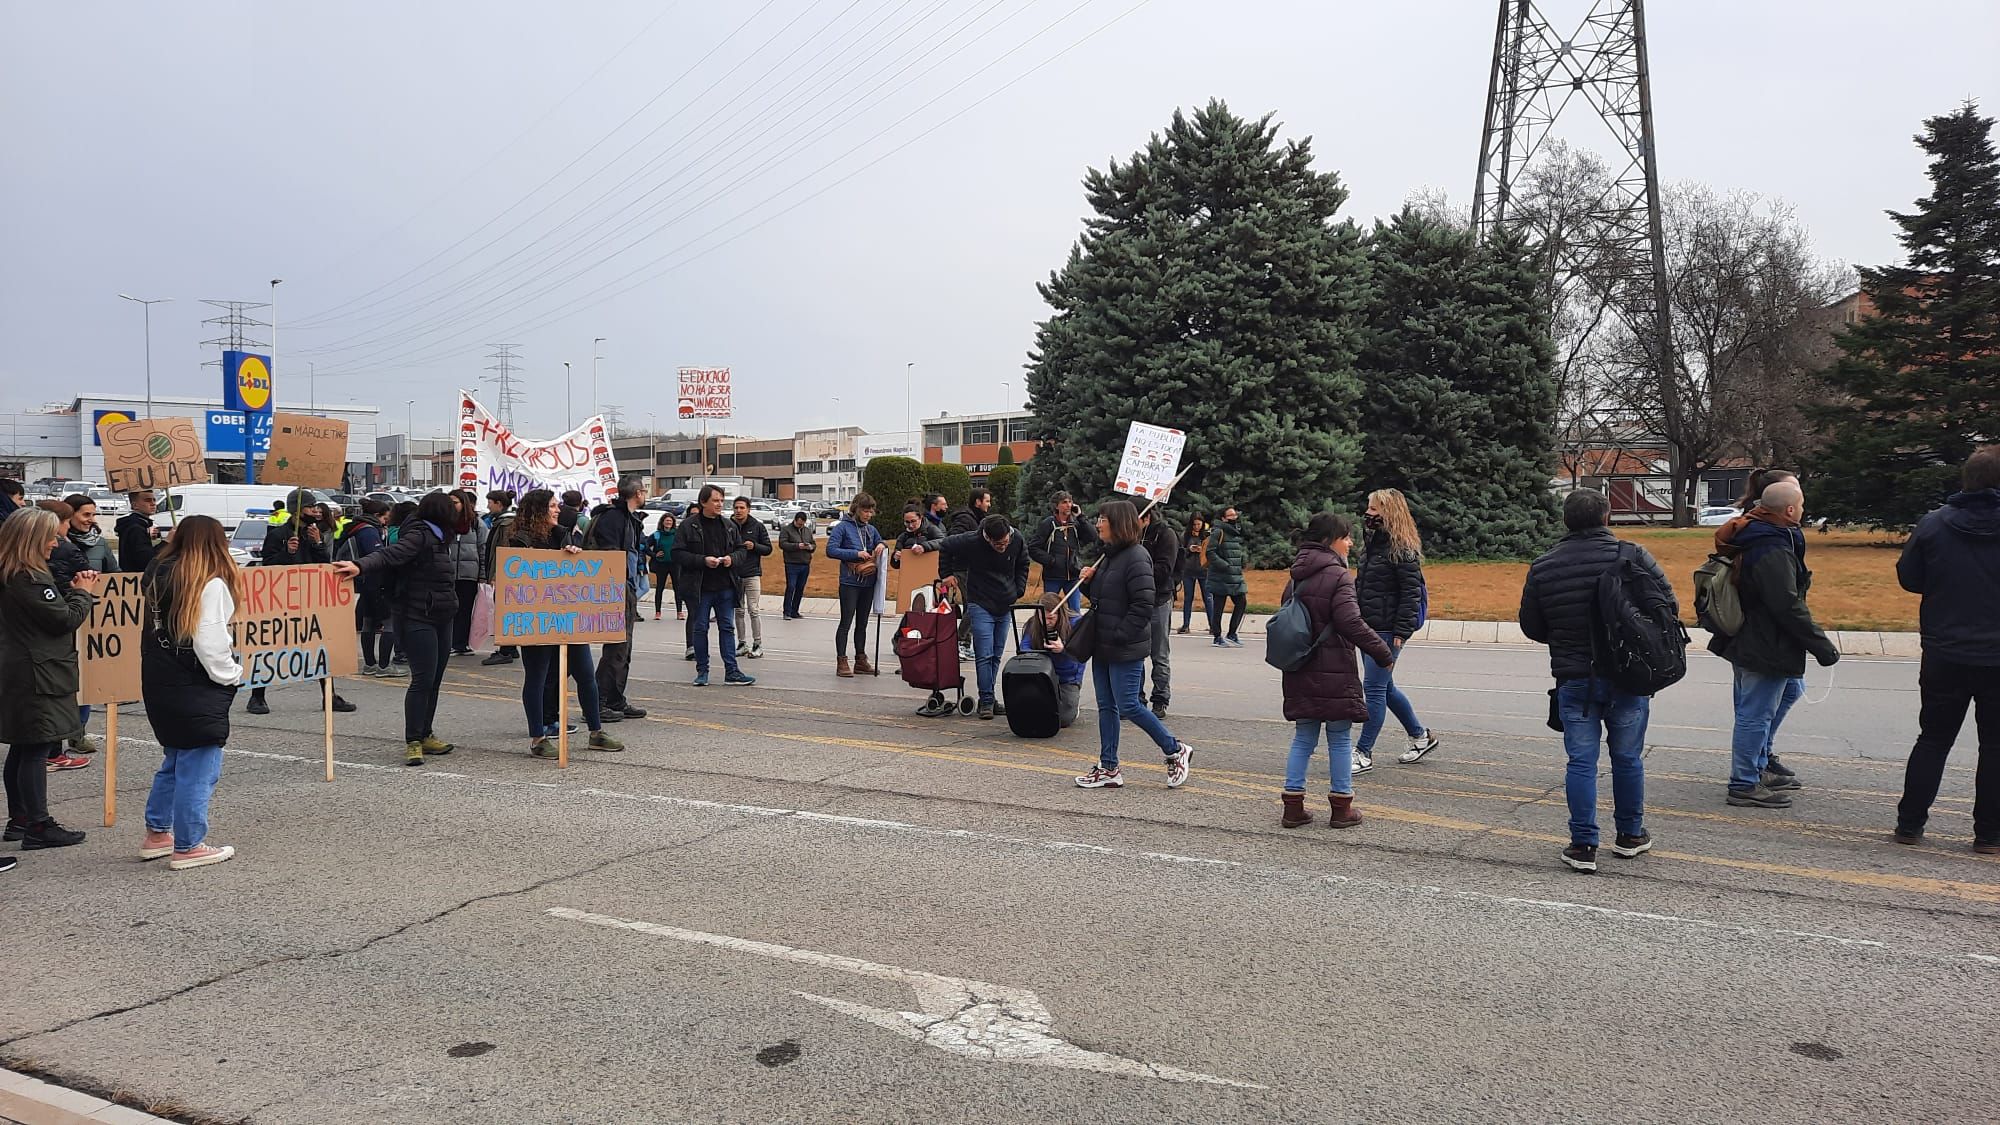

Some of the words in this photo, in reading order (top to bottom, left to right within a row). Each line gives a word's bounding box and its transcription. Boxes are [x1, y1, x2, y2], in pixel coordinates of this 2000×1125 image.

[681, 384, 695, 396] NO
[462, 407, 474, 415] CGT
[106, 423, 200, 463] SOS
[462, 430, 476, 438] CGT
[595, 452, 609, 460] CGT
[460, 479, 477, 487] CGT
[600, 473, 615, 481] CGT
[503, 555, 604, 580] CAMBRAY
[239, 565, 351, 616] ARKETING
[504, 583, 538, 606] NO
[540, 577, 626, 606] ASSOLEIX
[502, 612, 535, 637] PER
[536, 612, 578, 635] TANT
[87, 632, 121, 661] NO
